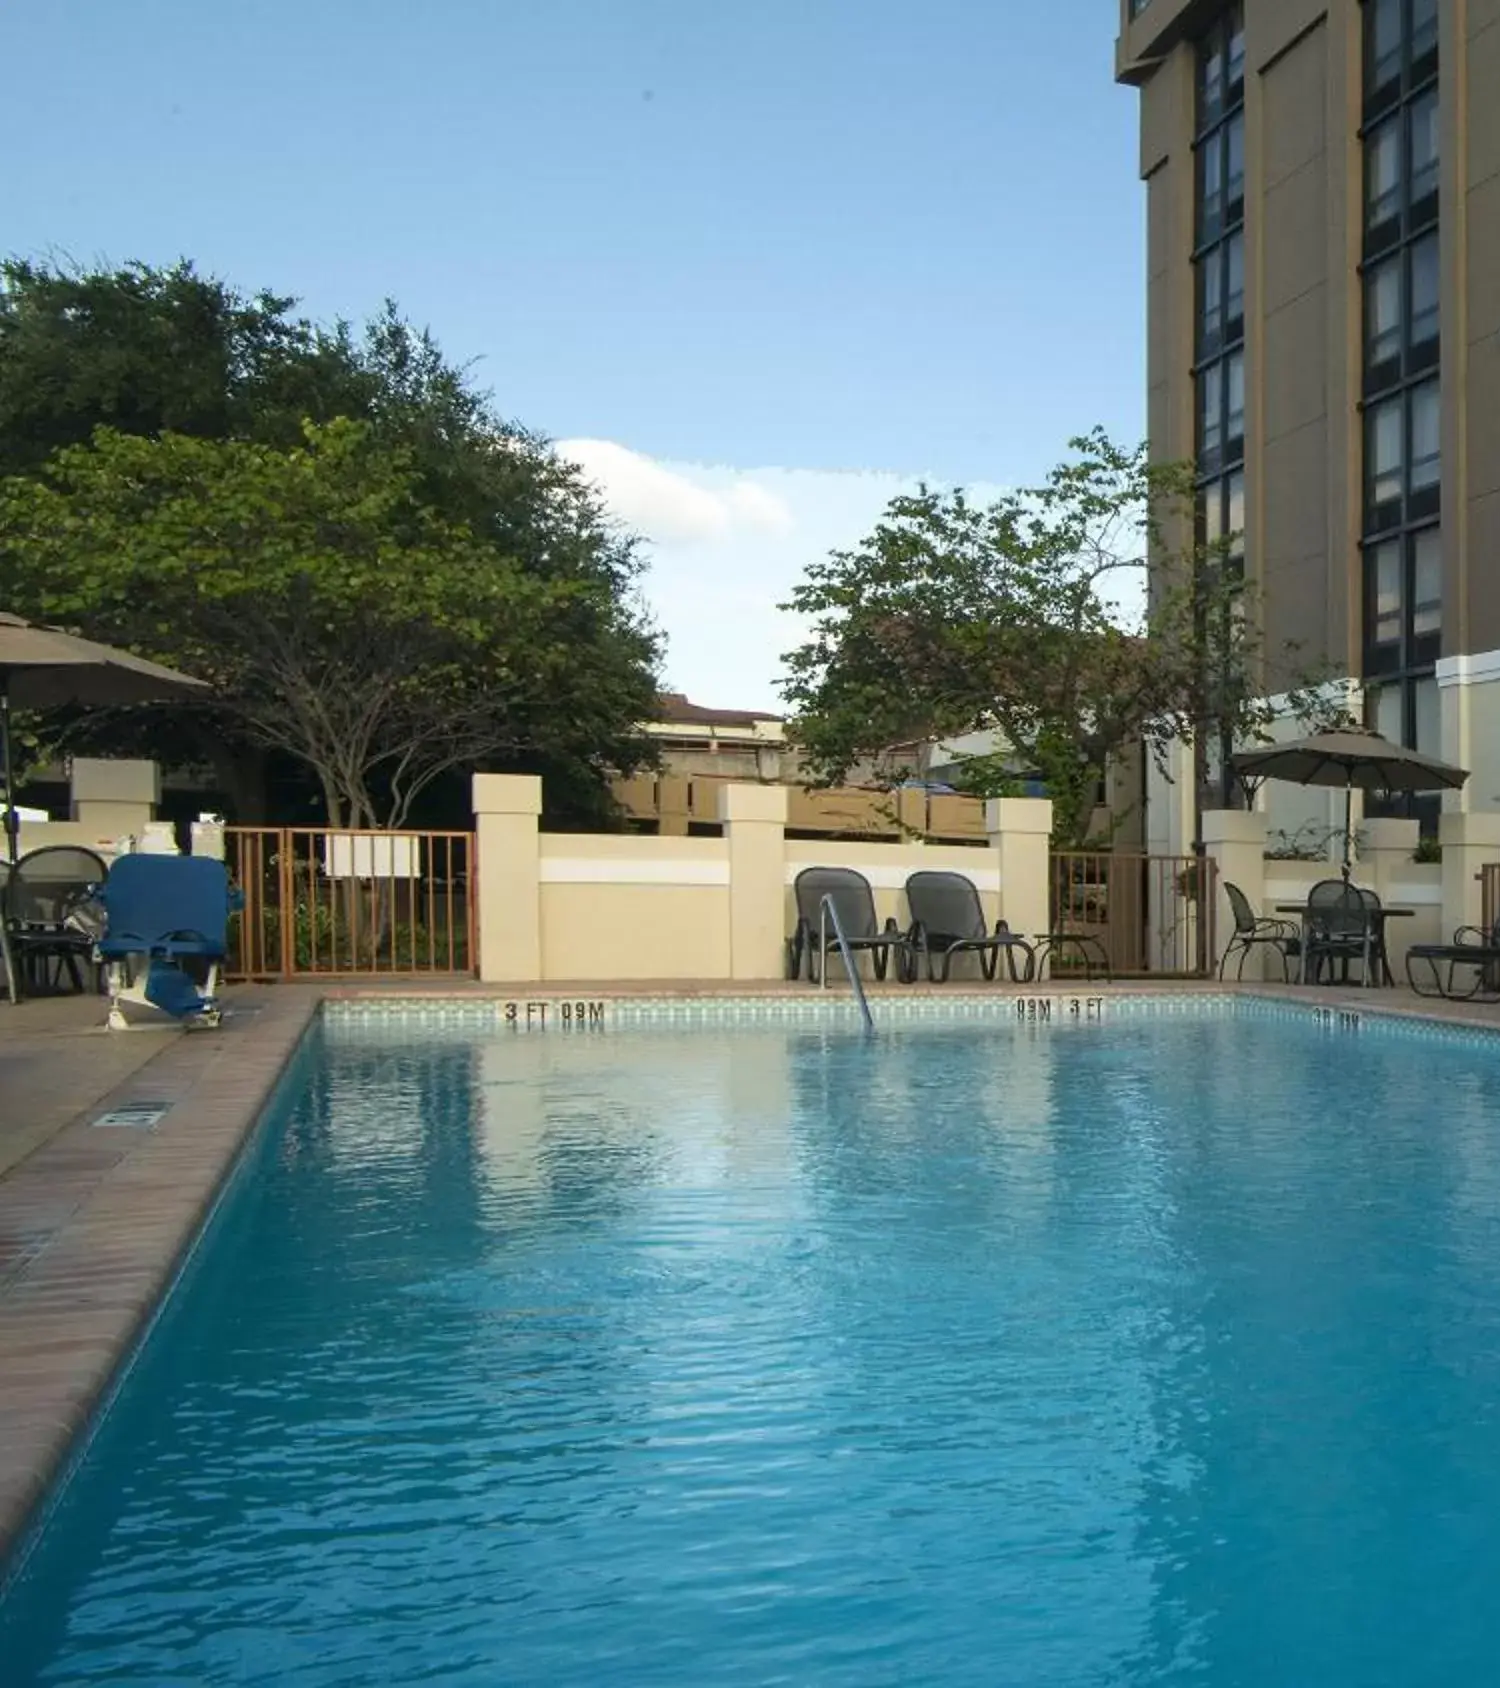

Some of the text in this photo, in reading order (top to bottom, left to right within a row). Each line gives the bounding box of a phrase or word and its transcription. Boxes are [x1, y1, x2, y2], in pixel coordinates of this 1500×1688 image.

[505, 1002, 518, 1020] 3
[527, 1002, 548, 1021] FT
[1070, 999, 1080, 1015] 3
[1087, 998, 1103, 1016] FT
